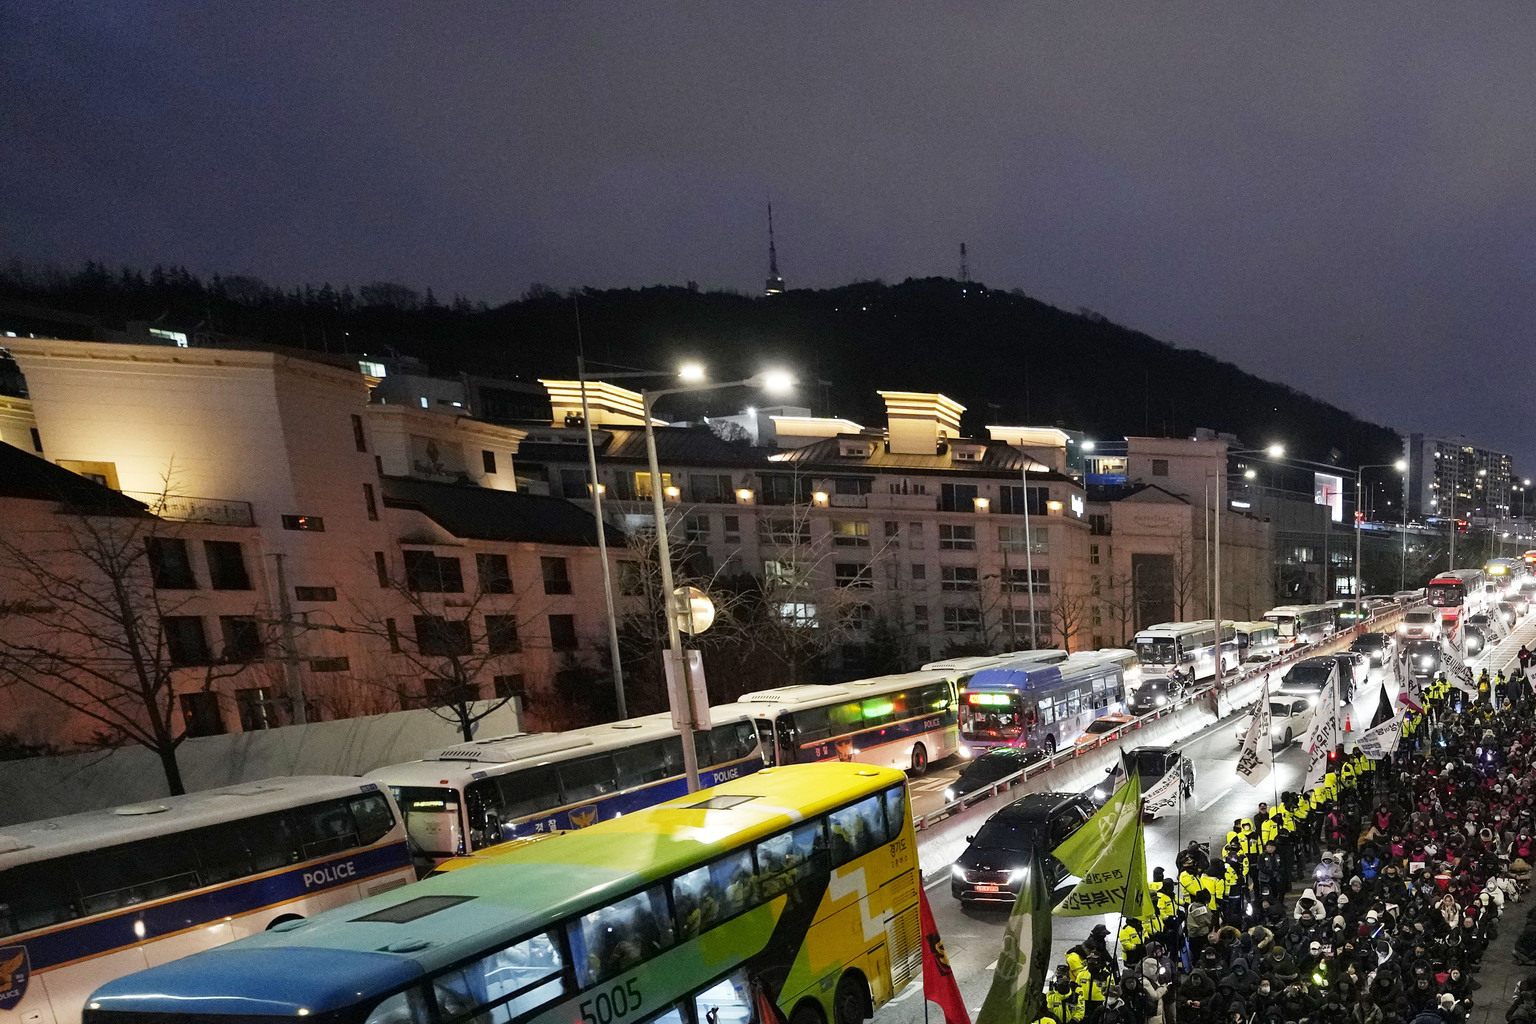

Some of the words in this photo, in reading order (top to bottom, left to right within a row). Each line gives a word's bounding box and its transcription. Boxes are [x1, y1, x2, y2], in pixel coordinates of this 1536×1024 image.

[923, 718, 940, 729] POLICE
[713, 767, 739, 784] POLICE
[534, 818, 558, 834] 경찰
[888, 837, 906, 860] 경기도
[303, 861, 357, 889] POLICE
